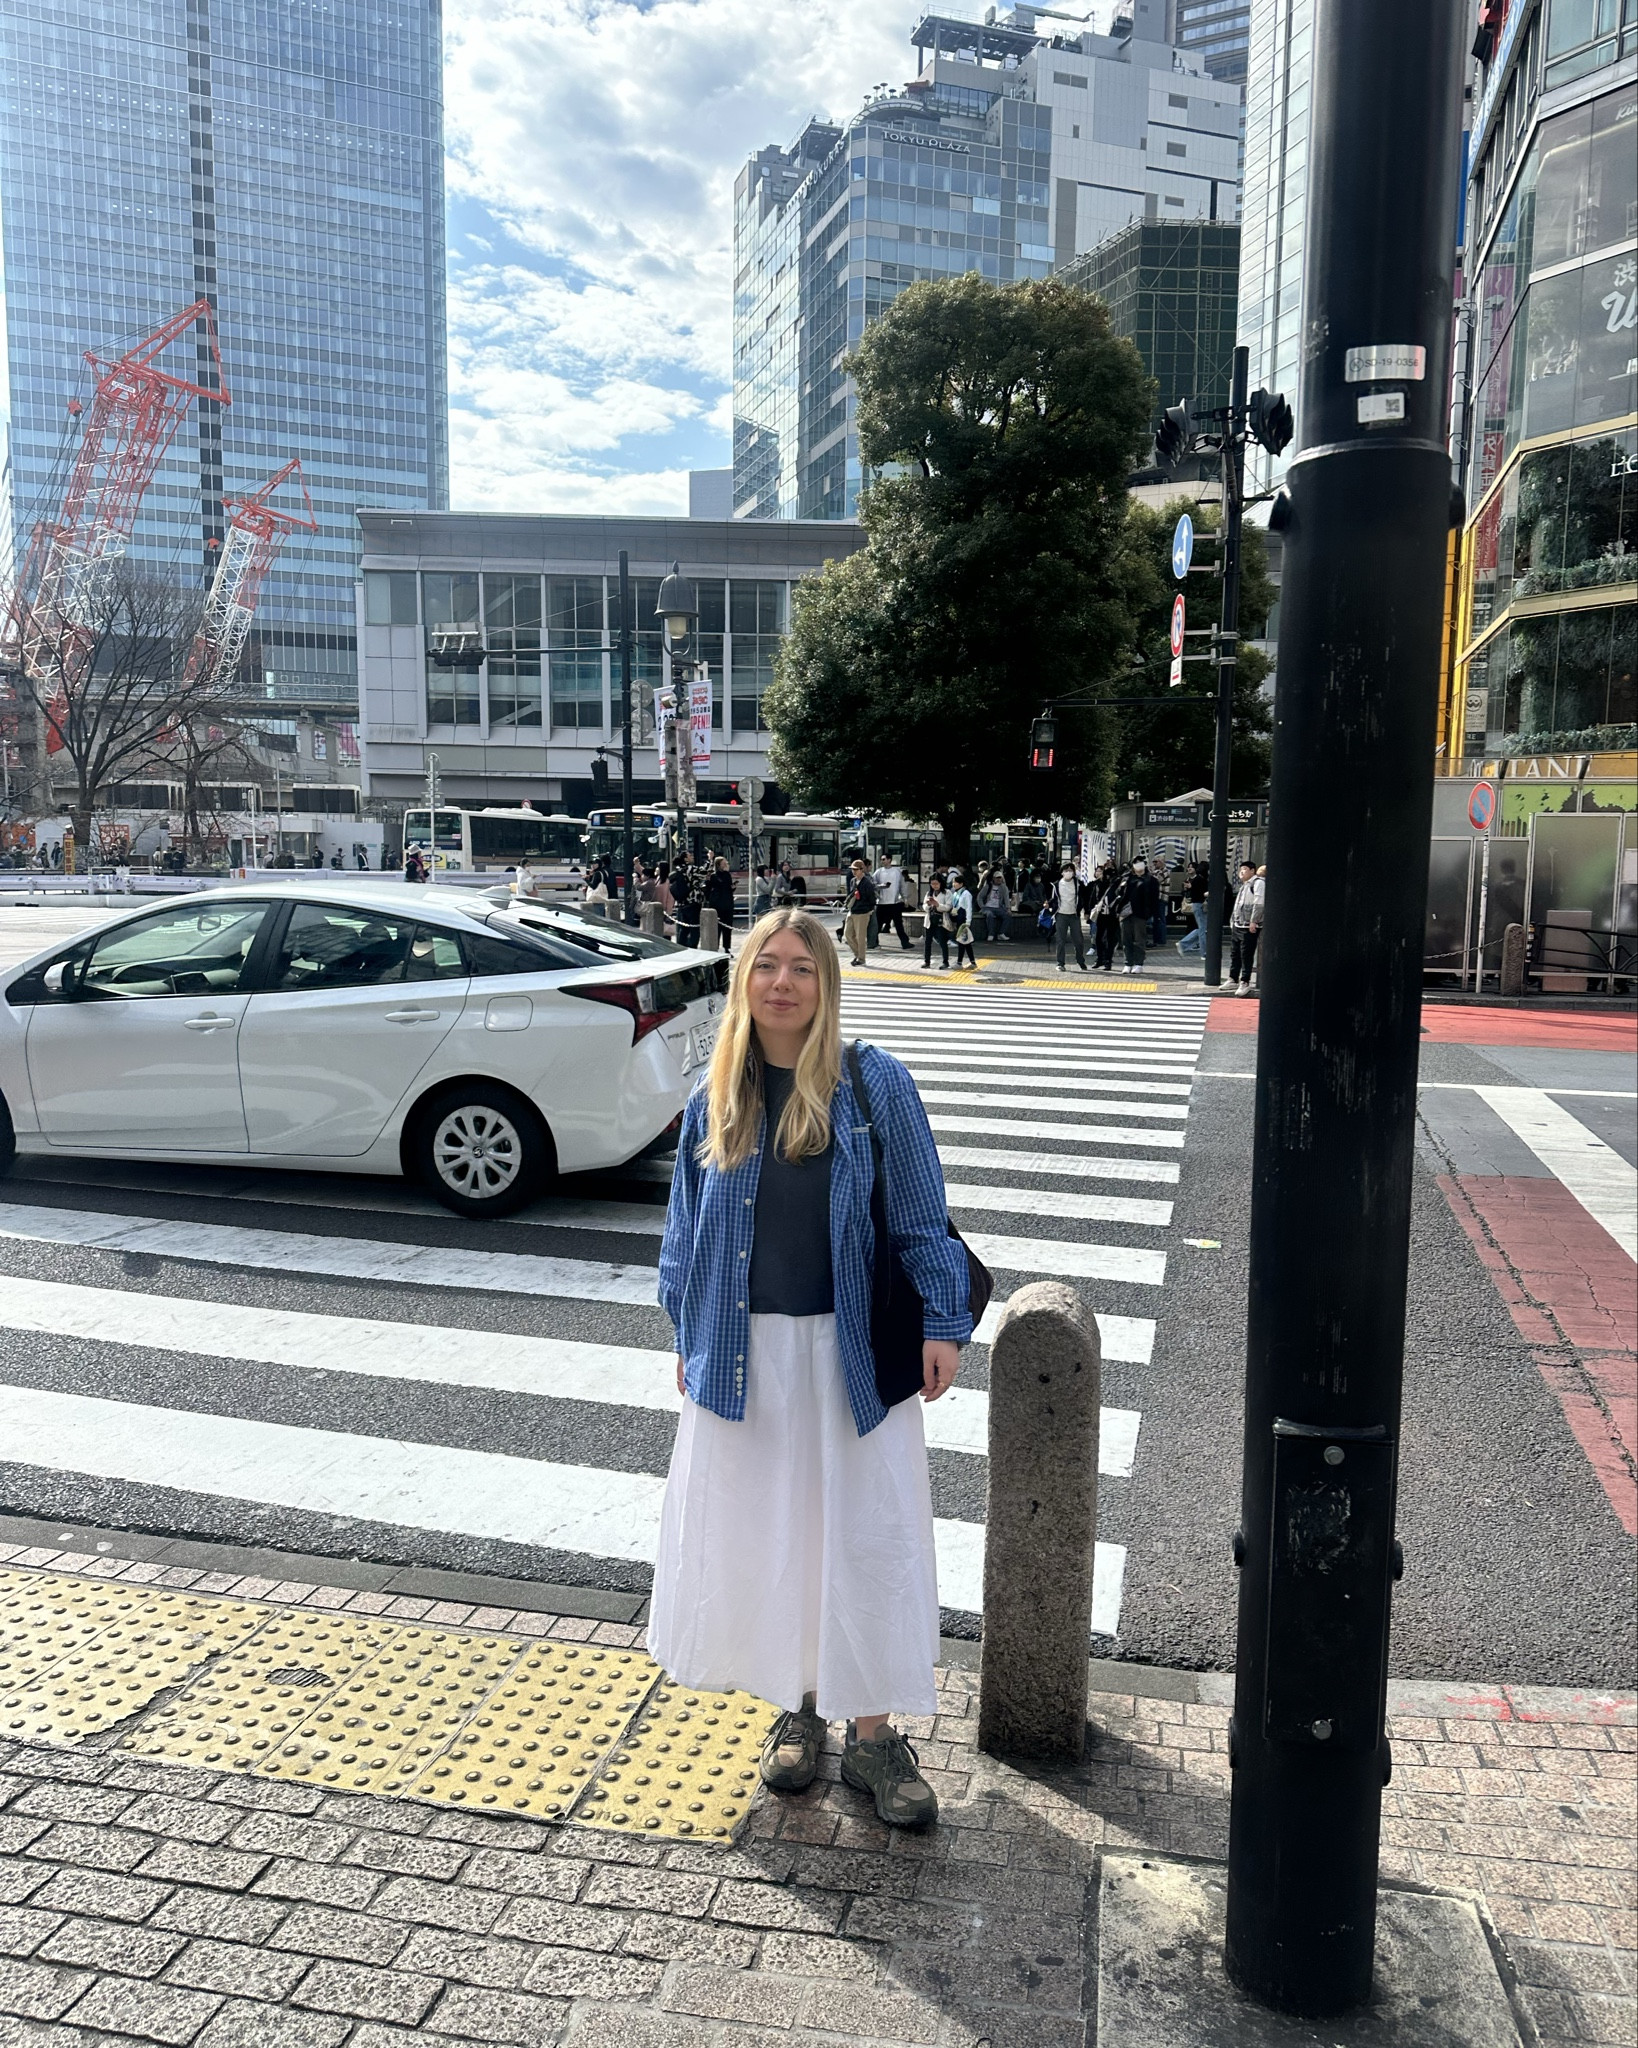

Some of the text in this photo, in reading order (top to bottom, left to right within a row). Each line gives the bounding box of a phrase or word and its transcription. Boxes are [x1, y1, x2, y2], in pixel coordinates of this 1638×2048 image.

[883, 130, 971, 153] TOKYU PLAZA
[697, 816, 729, 825] HYBRID
